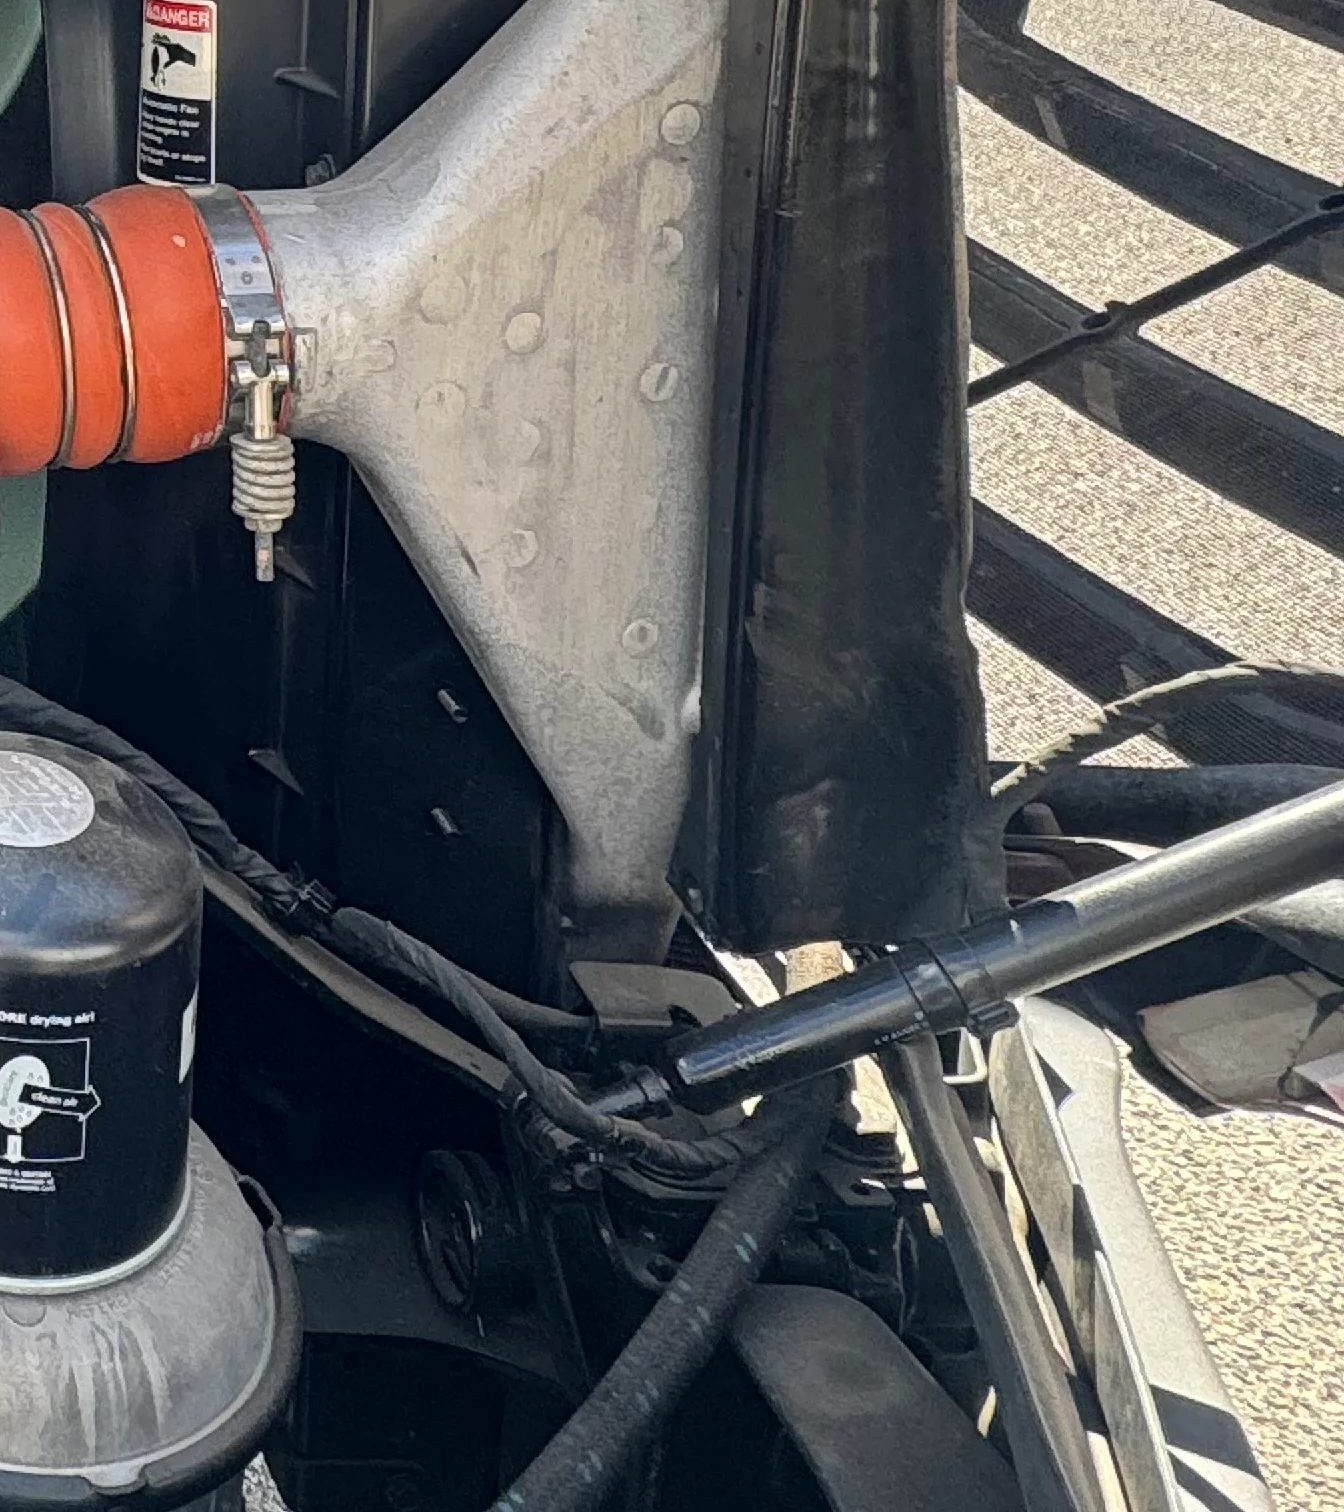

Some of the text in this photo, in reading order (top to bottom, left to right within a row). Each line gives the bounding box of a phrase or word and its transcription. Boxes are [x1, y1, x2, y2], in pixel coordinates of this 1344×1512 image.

[154, 6, 210, 29] DANGER
[29, 1015, 72, 1029] drying
[74, 1010, 96, 1024] air!
[31, 1092, 79, 1107] clean air
